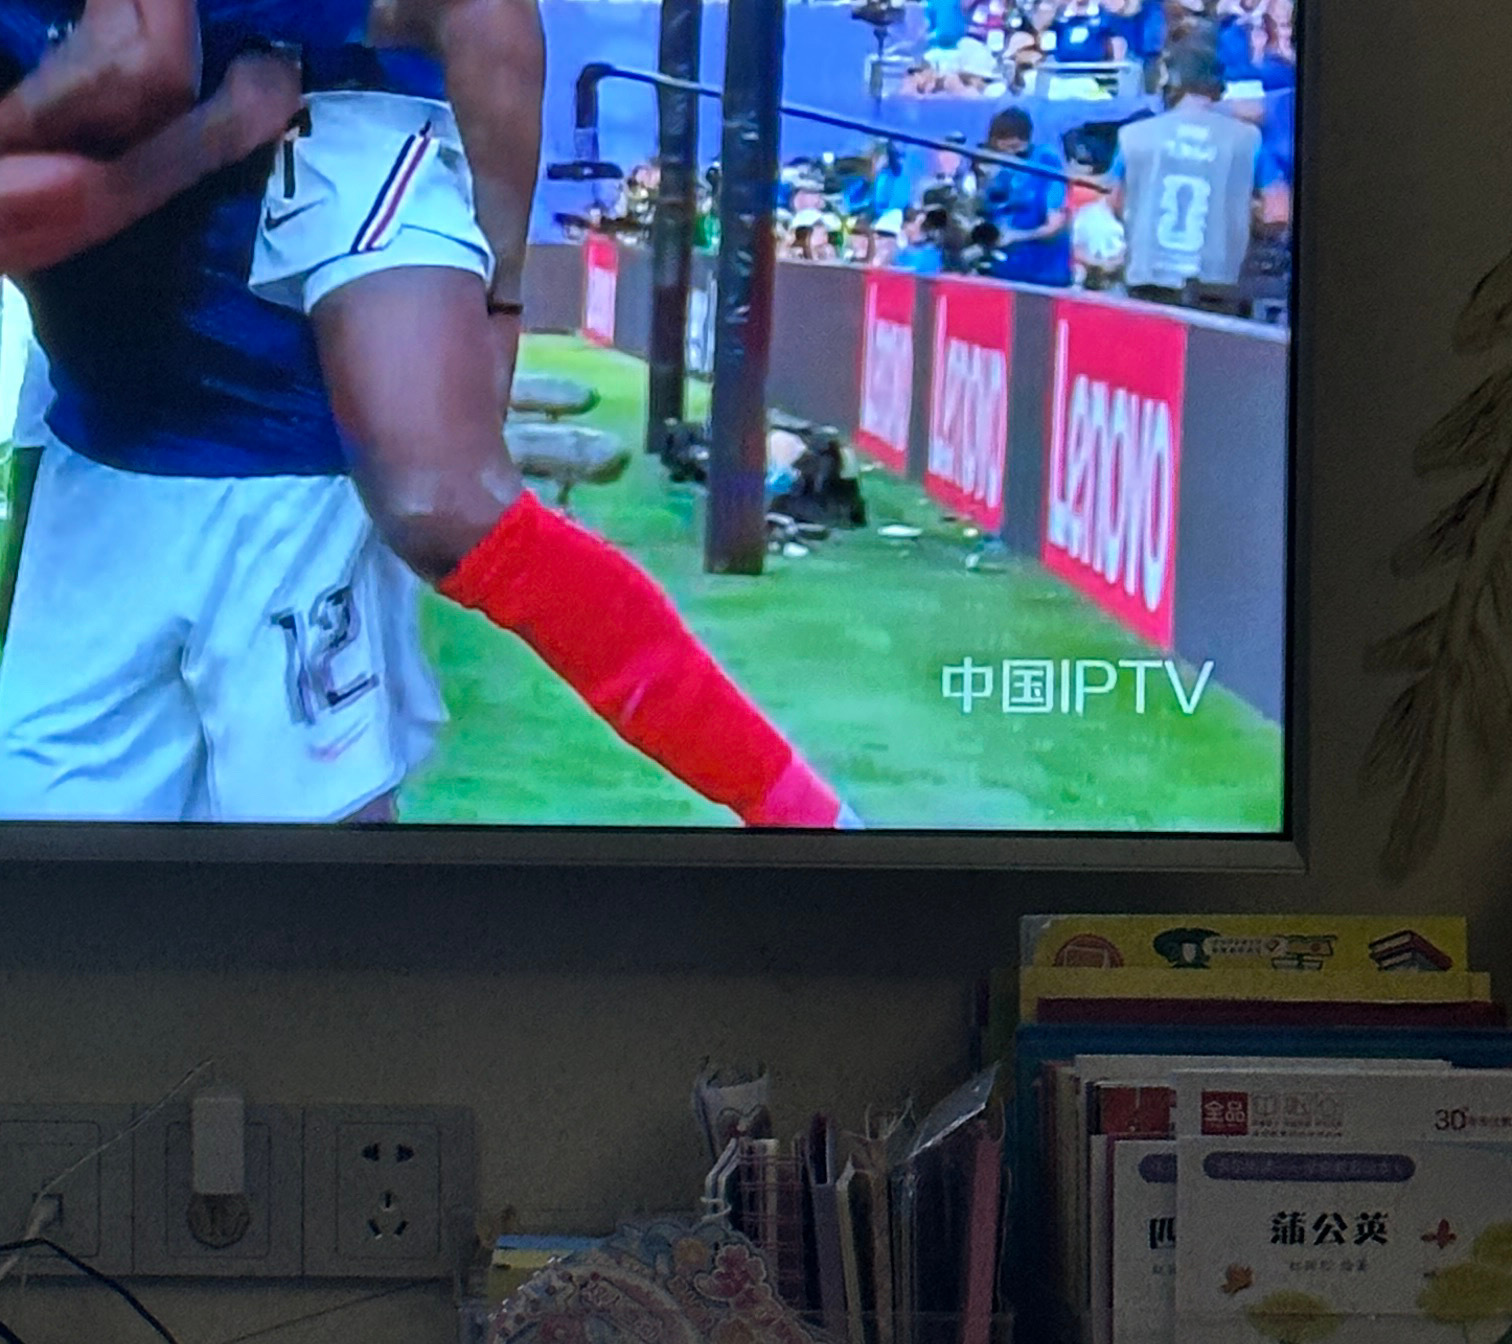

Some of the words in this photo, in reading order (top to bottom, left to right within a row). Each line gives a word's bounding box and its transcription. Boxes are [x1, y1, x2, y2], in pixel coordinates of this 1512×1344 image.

[268, 584, 380, 727] 12
[941, 656, 1215, 716] 中国IPTV
[1203, 1099, 1246, 1123] 全品
[1270, 1210, 1389, 1247] 蒲公英
